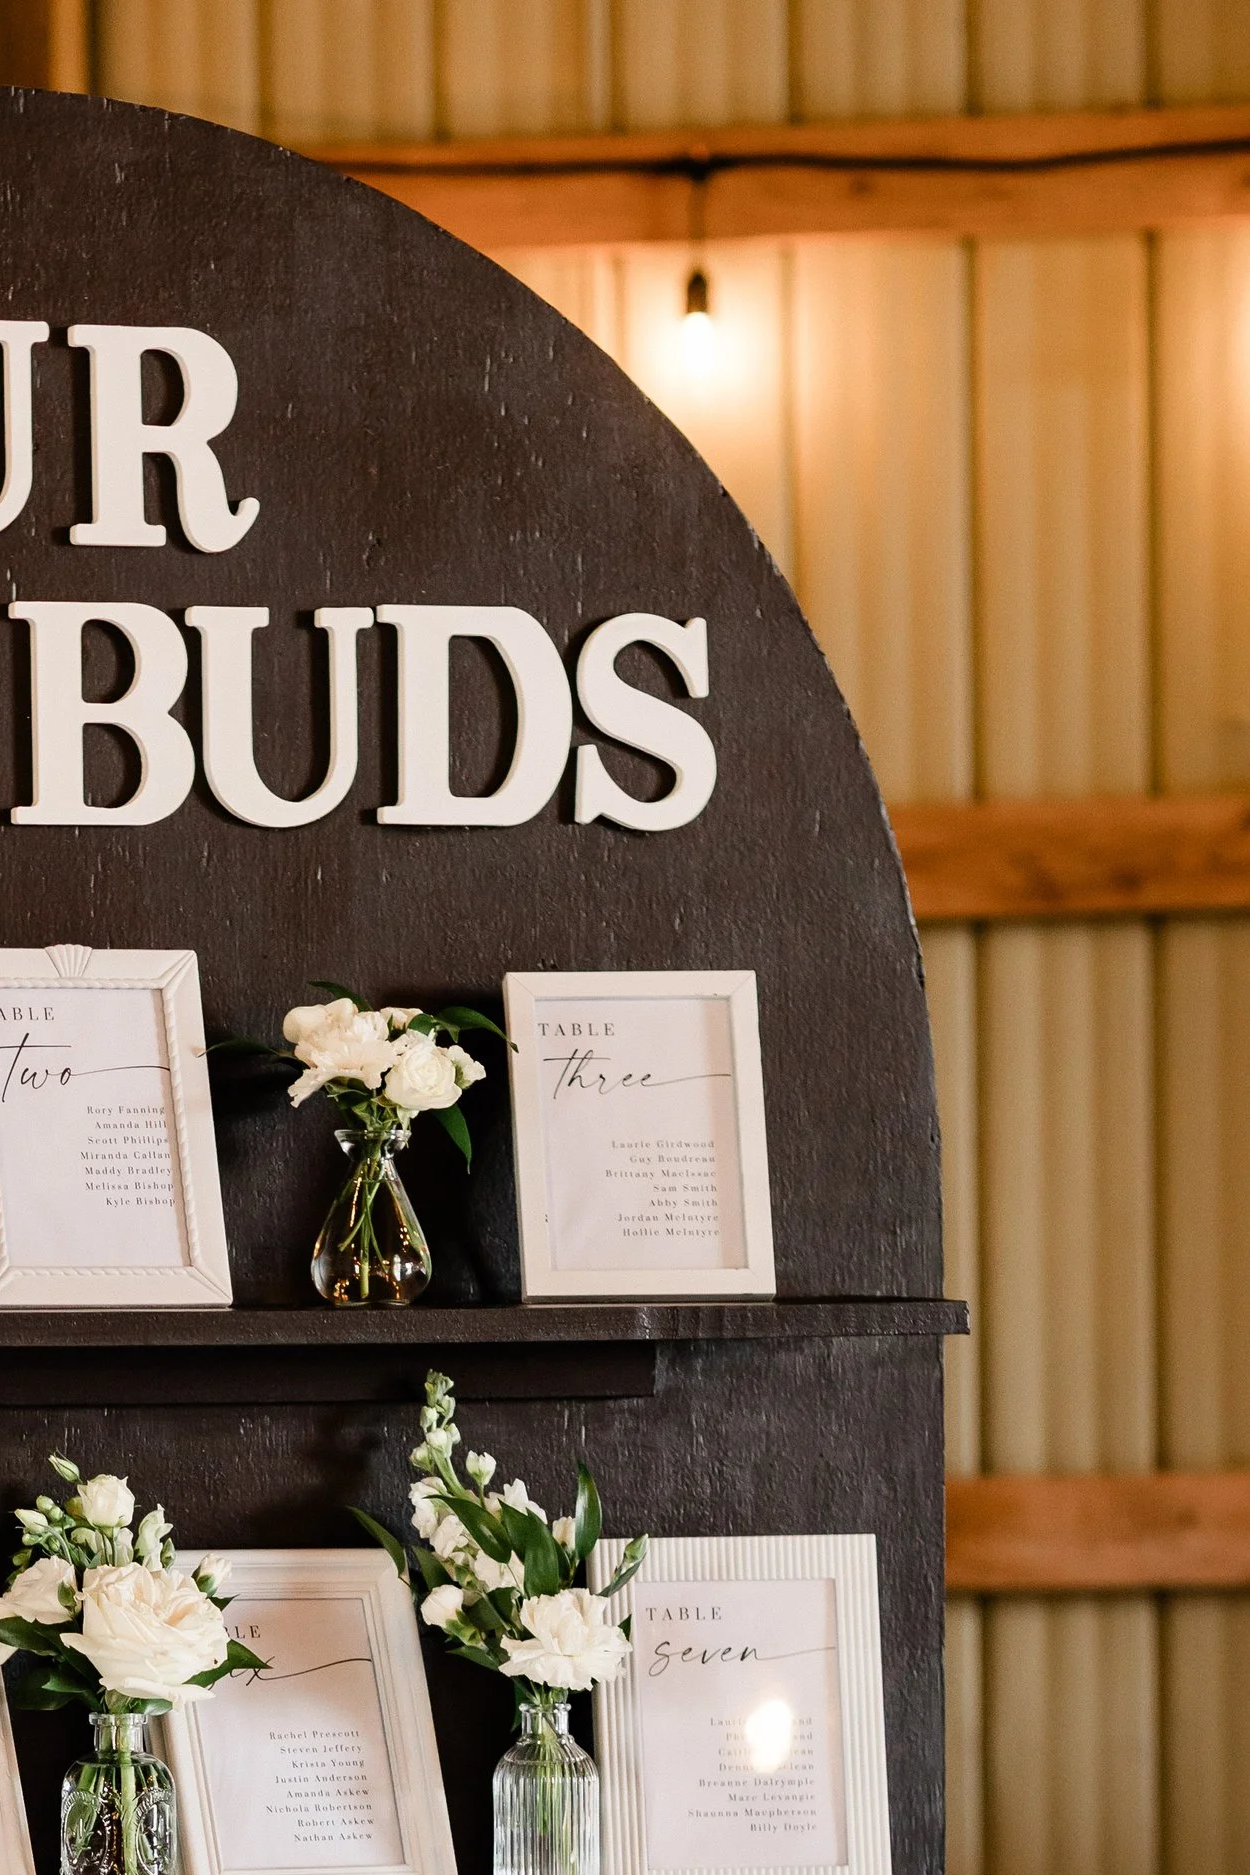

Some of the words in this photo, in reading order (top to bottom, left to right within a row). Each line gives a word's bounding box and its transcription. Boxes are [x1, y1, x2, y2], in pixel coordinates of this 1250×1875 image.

[7, 600, 719, 833] BUDS
[538, 1023, 615, 1036] TABLE
[543, 1049, 731, 1099] three
[87, 1106, 112, 1115] Rory
[119, 1106, 164, 1115] Fanning
[123, 1136, 169, 1146] Phillips
[81, 1152, 128, 1160] Miranda
[134, 1151, 170, 1159] Callan
[85, 1167, 121, 1176] Maddy
[128, 1167, 171, 1176] Bradley
[135, 1182, 174, 1191] Bishop
[106, 1198, 130, 1207] Kyle
[136, 1197, 175, 1206] Bishop
[650, 1200, 677, 1208] Abby
[618, 1214, 658, 1222] Jordan
[646, 1606, 722, 1621] TABLE
[649, 1641, 836, 1677] seven
[270, 1731, 306, 1740] Rachel
[324, 1745, 362, 1753] Jeffery
[315, 1774, 367, 1782] Anderson
[287, 1790, 330, 1798] Amanda
[336, 1788, 370, 1796] Askew
[266, 1805, 309, 1813] Nichola
[294, 1833, 333, 1842] Nathan
[340, 1832, 372, 1840] Askew
